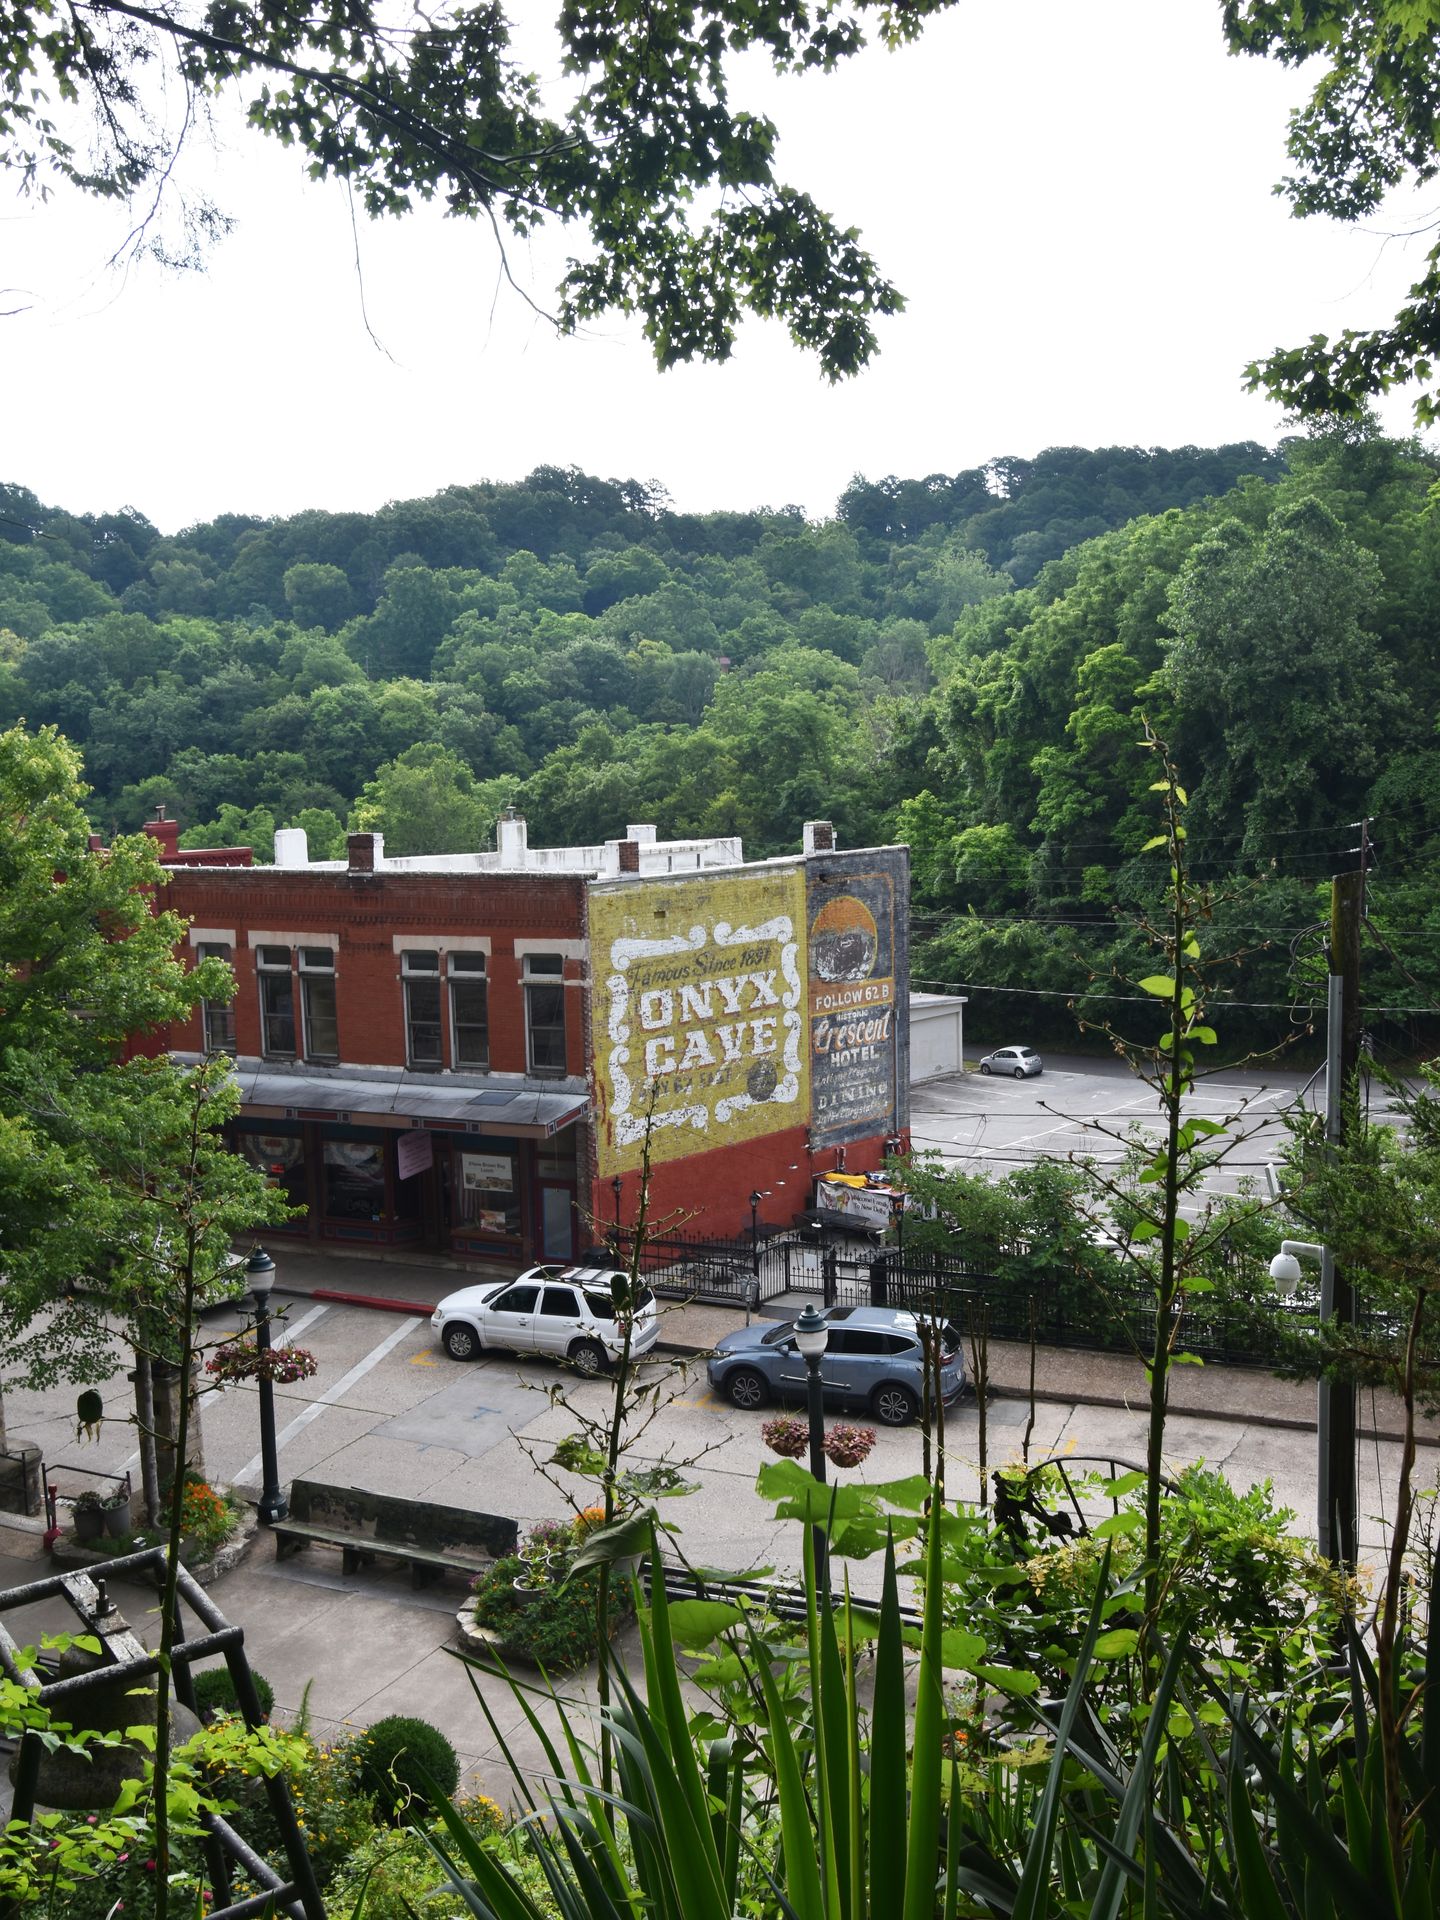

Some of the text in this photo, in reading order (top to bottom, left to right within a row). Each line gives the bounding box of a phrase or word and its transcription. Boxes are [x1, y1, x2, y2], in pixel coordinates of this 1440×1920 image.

[627, 962, 690, 988] Famous
[693, 951, 737, 977] Since
[640, 969, 780, 1030] ONYX
[816, 984, 889, 1010] FOLLOW 62 B
[645, 1016, 777, 1076] CAVE
[814, 1010, 890, 1052] Crescent
[830, 1045, 880, 1067] HOTEL
[818, 1082, 888, 1110] DINING
